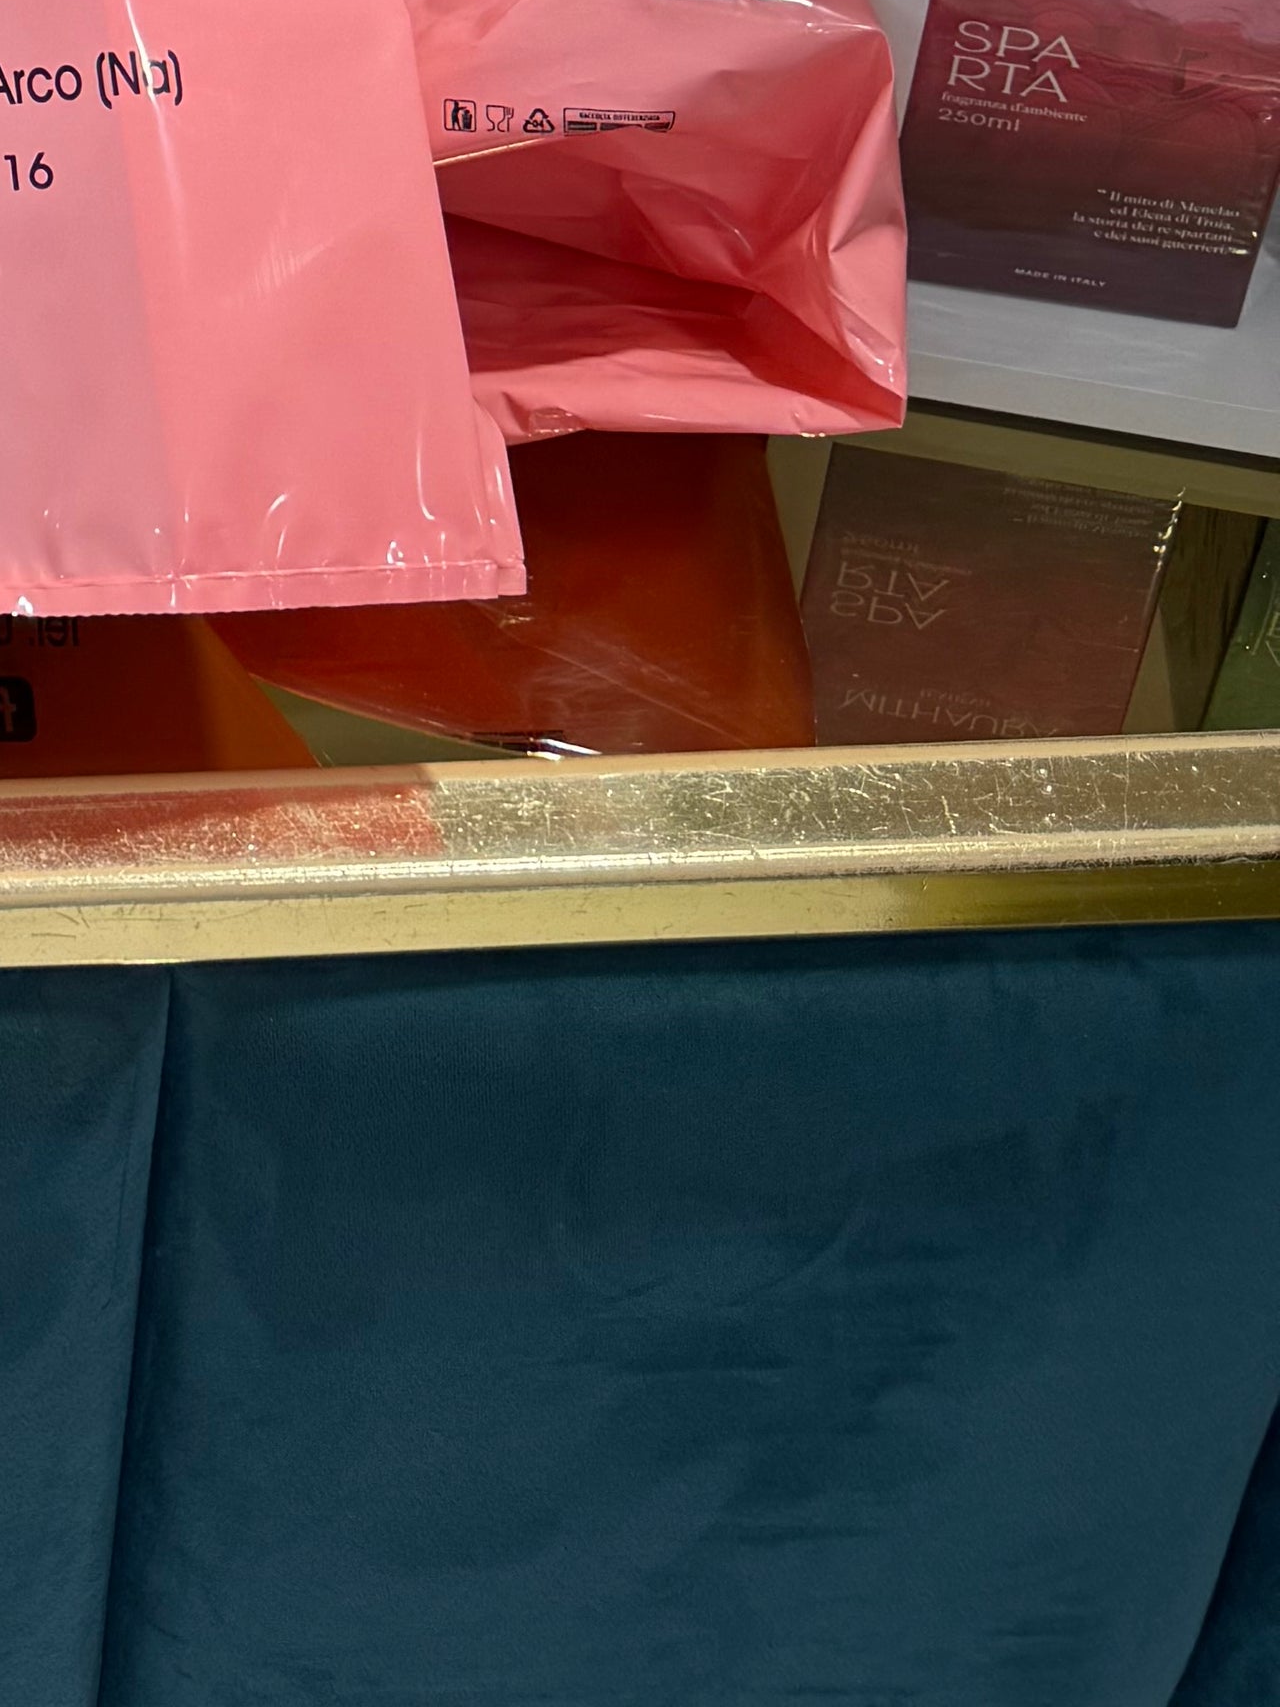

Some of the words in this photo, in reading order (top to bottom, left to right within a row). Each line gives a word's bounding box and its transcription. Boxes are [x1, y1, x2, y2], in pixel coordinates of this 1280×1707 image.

[954, 20, 1080, 69] SPA
[97, 50, 182, 109] (Na)
[947, 54, 1068, 103] RTA
[938, 107, 1021, 132] 250ml
[4, 152, 53, 191] 16
[1014, 268, 1050, 279] MADE
[1053, 273, 1067, 282] IN
[1071, 277, 1106, 287] ITALY
